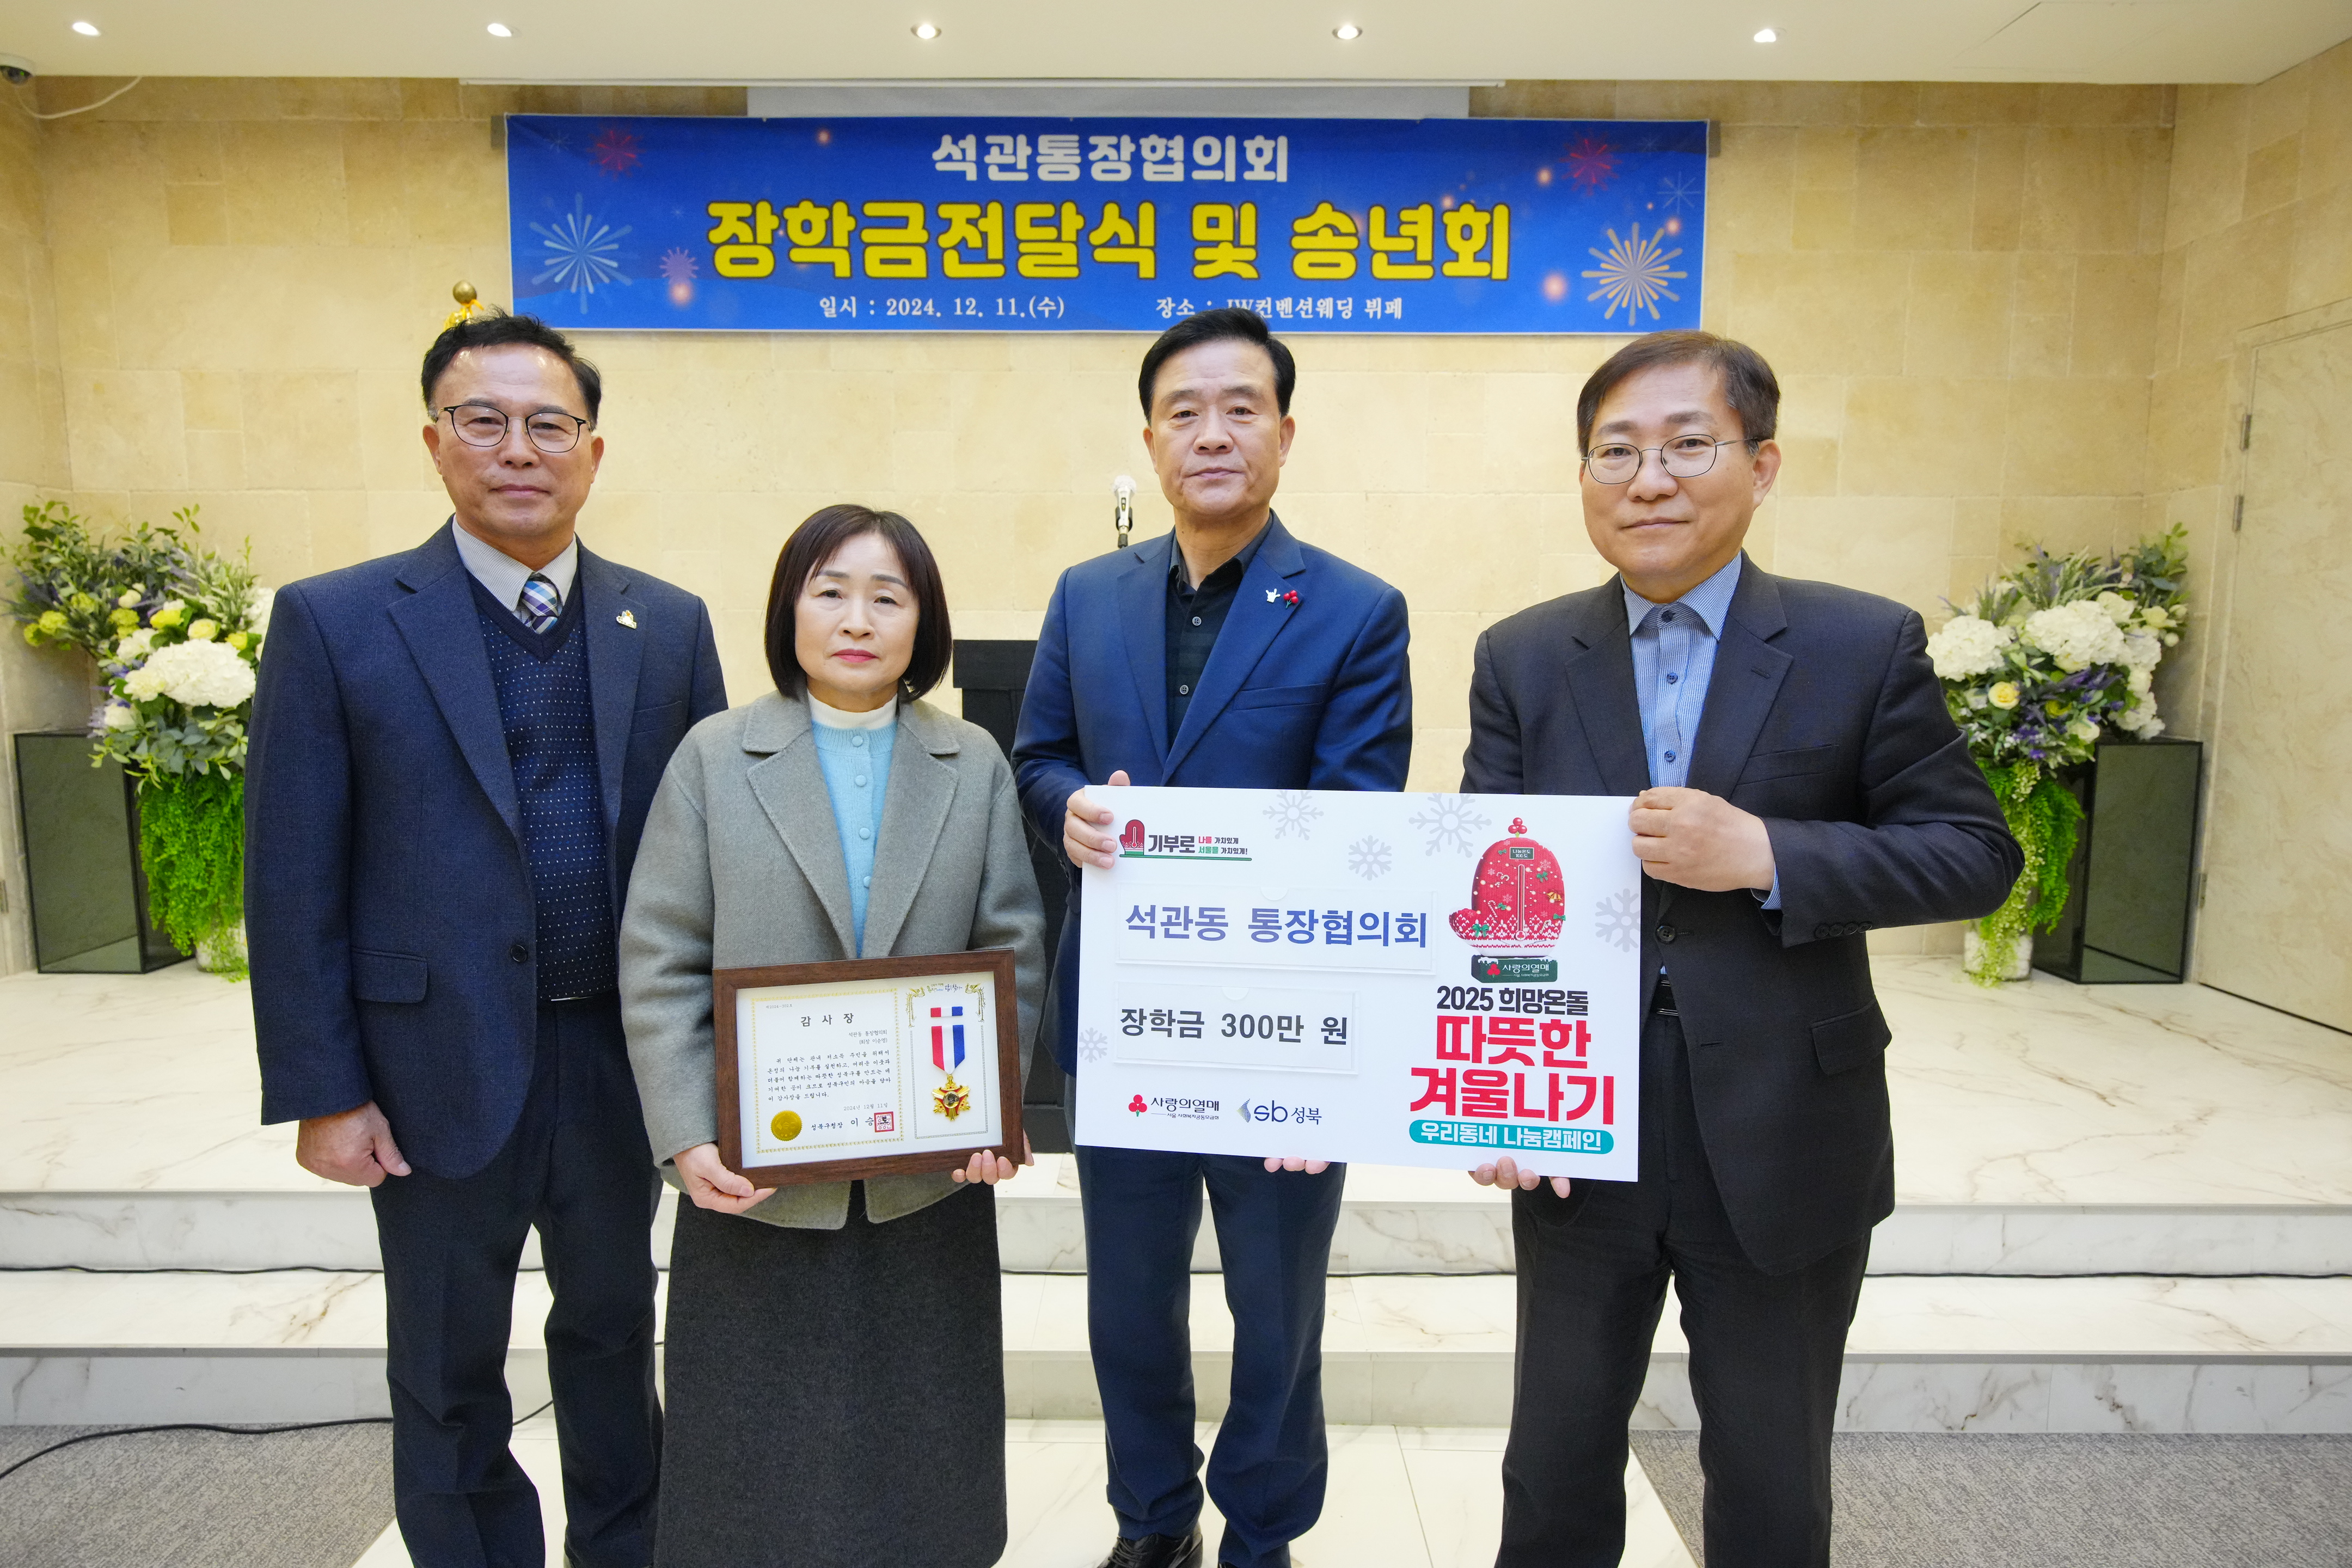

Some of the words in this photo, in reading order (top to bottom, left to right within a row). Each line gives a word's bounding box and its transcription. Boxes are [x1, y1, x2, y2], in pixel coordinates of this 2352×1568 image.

[932, 134, 1288, 182] 석관통장협의회
[707, 199, 1156, 279] 장학금전달식
[1191, 201, 1259, 279] 및
[1290, 201, 1510, 280] 송년회
[819, 297, 857, 318] 일시
[886, 298, 941, 318] 2024.
[954, 298, 983, 318] 12.
[996, 296, 1065, 319] 11.(수)
[1156, 297, 1195, 318] 장소
[1364, 297, 1403, 320] 뷔페
[1148, 835, 1195, 853] 기부로
[1125, 905, 1229, 942] 석관동
[1248, 907, 1427, 948] 통장협의회
[1502, 964, 1549, 973] 사랑의열매
[1436, 986, 1493, 1011] 2025
[1499, 988, 1588, 1016] 희망온돌
[1120, 1008, 1204, 1039] 장학금
[1221, 1013, 1304, 1043] 300만
[1321, 1017, 1347, 1045] 원
[1436, 1015, 1591, 1069] 따뜻한
[1150, 1097, 1220, 1113] 사랑의열매
[1410, 1066, 1614, 1125] 겨울나기
[811, 1122, 843, 1131] 성북구청장
[1254, 1100, 1288, 1123] sb
[1291, 1106, 1322, 1125] 성북
[1420, 1122, 1498, 1146] 우리동네
[1503, 1128, 1601, 1152] 나눔캠페인
